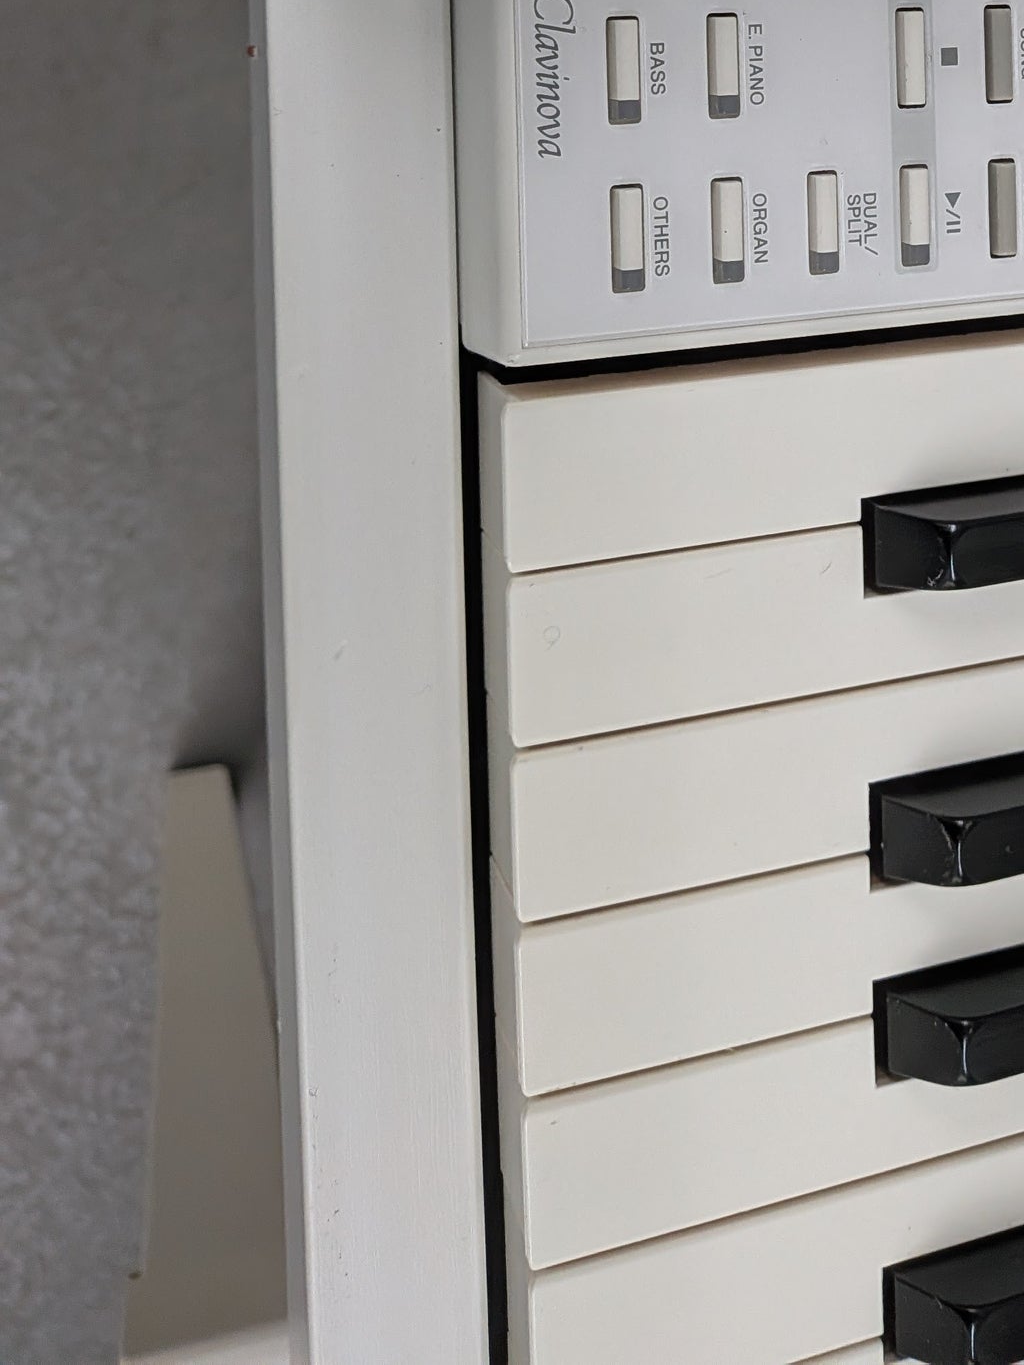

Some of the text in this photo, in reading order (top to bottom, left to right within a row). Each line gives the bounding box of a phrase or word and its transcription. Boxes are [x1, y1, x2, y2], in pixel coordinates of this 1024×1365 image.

[650, 42, 666, 95] BASS
[749, 45, 764, 105] PIANO
[652, 196, 670, 277] OTHERS
[752, 193, 768, 264] ORGAN
[847, 194, 862, 247] SPLIT
